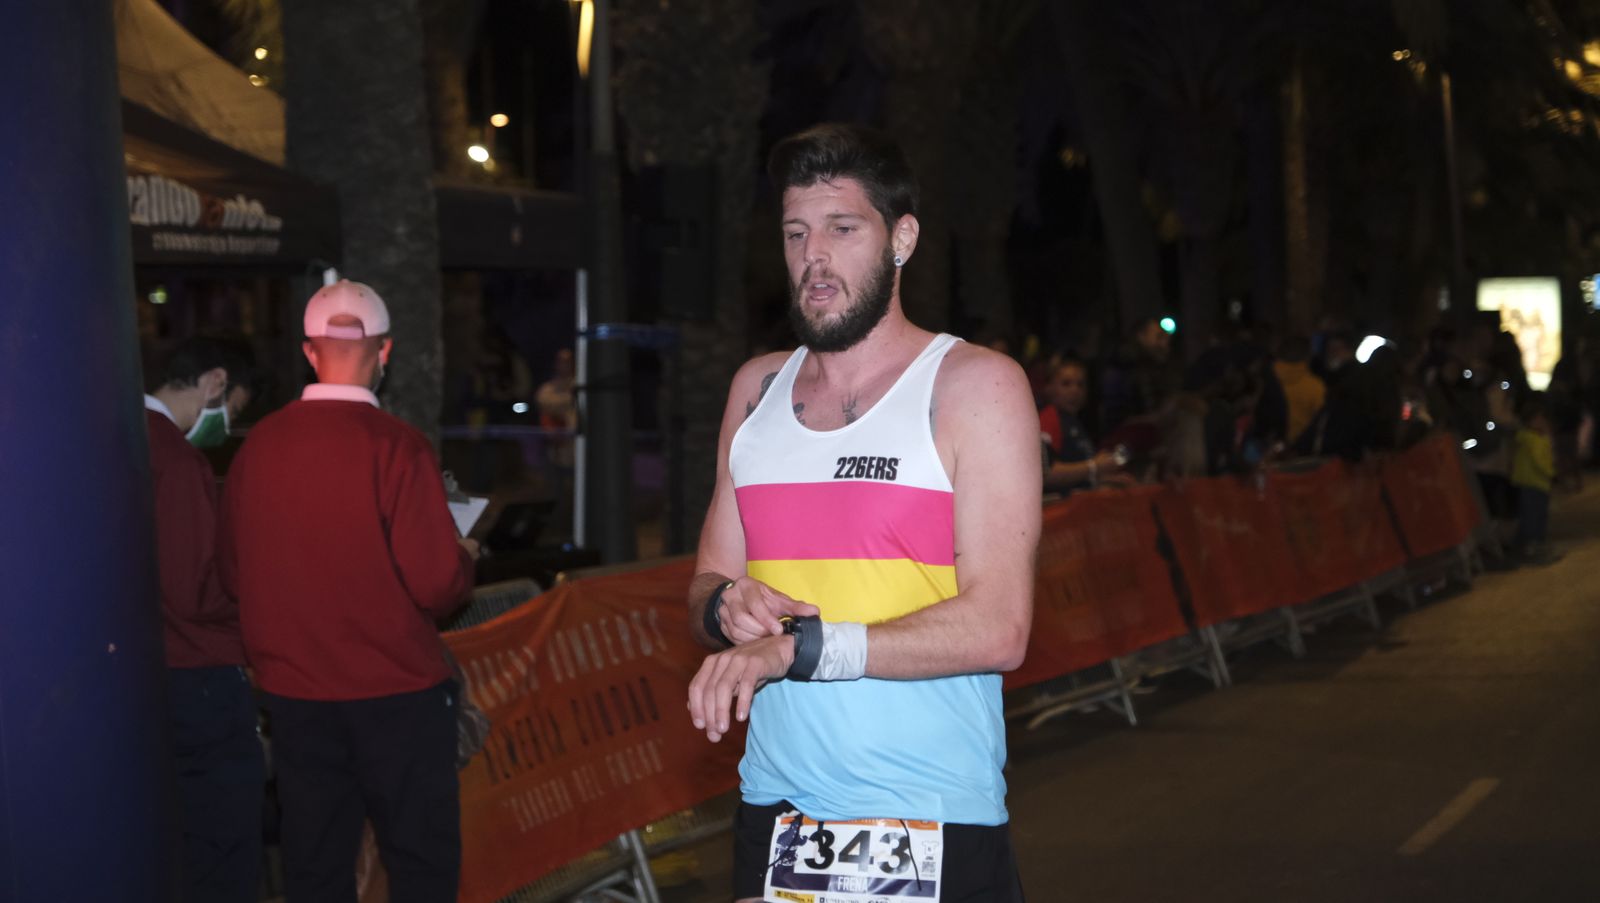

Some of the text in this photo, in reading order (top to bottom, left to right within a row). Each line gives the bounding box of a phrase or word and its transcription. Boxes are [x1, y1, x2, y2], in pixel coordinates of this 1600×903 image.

[834, 456, 899, 481] 226ERS
[804, 829, 912, 875] 343
[837, 875, 869, 892] FRENA
